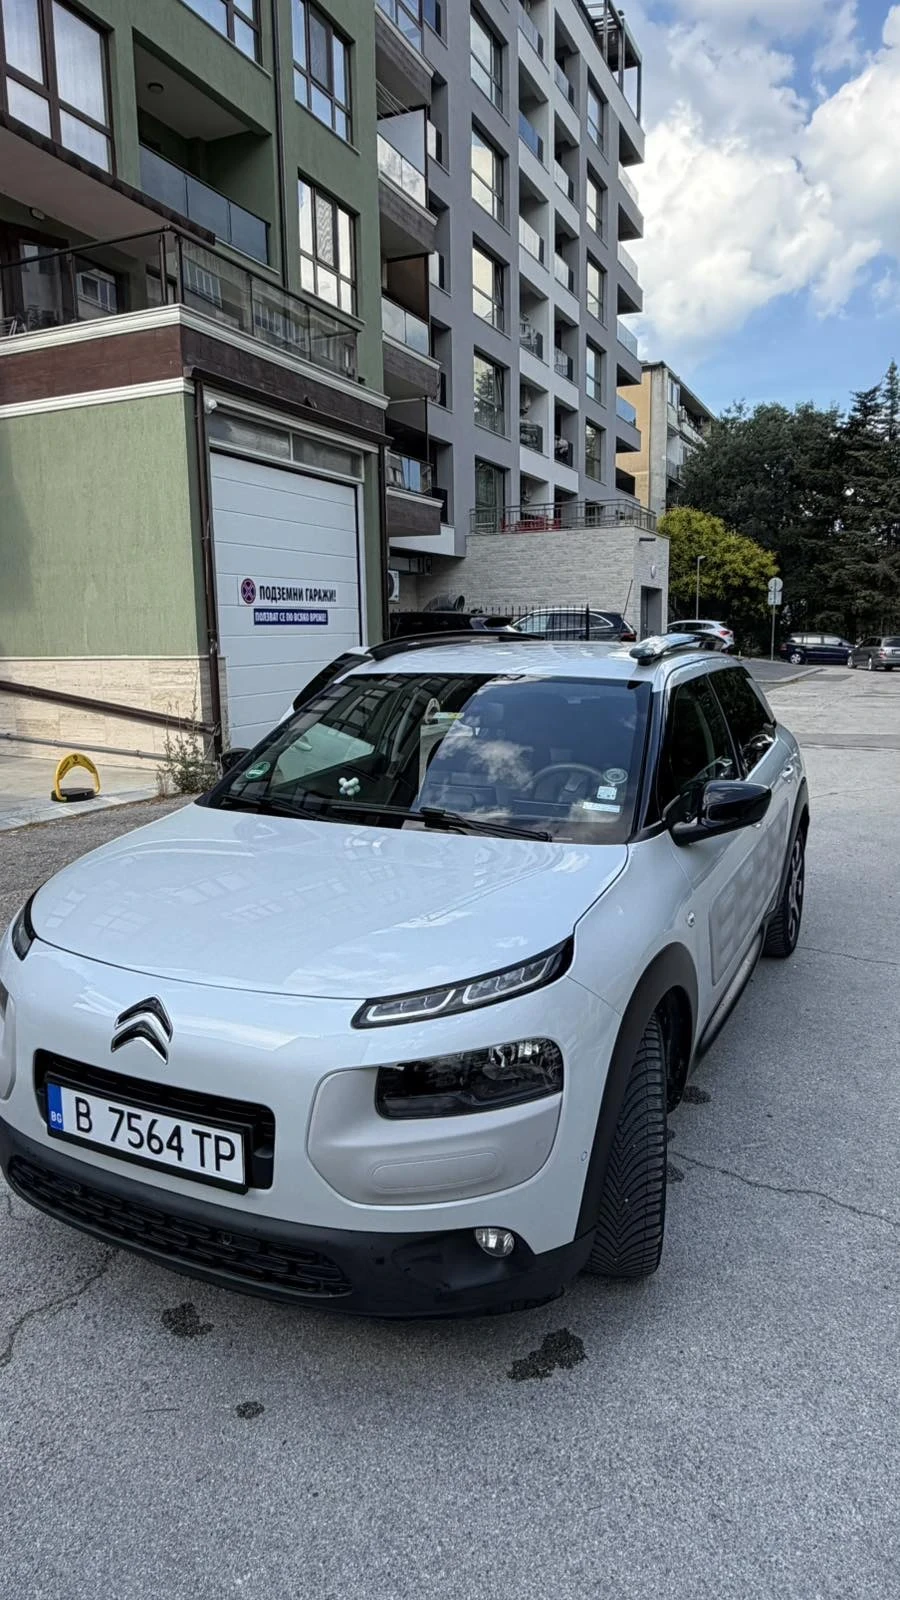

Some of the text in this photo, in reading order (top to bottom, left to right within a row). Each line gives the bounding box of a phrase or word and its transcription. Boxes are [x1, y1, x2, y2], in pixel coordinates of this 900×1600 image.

[259, 585, 337, 604] ПОДЗЕМНИ ГАРАЖИ!
[51, 1111, 62, 1124] BG
[75, 1096, 236, 1172] B 7564 TP
